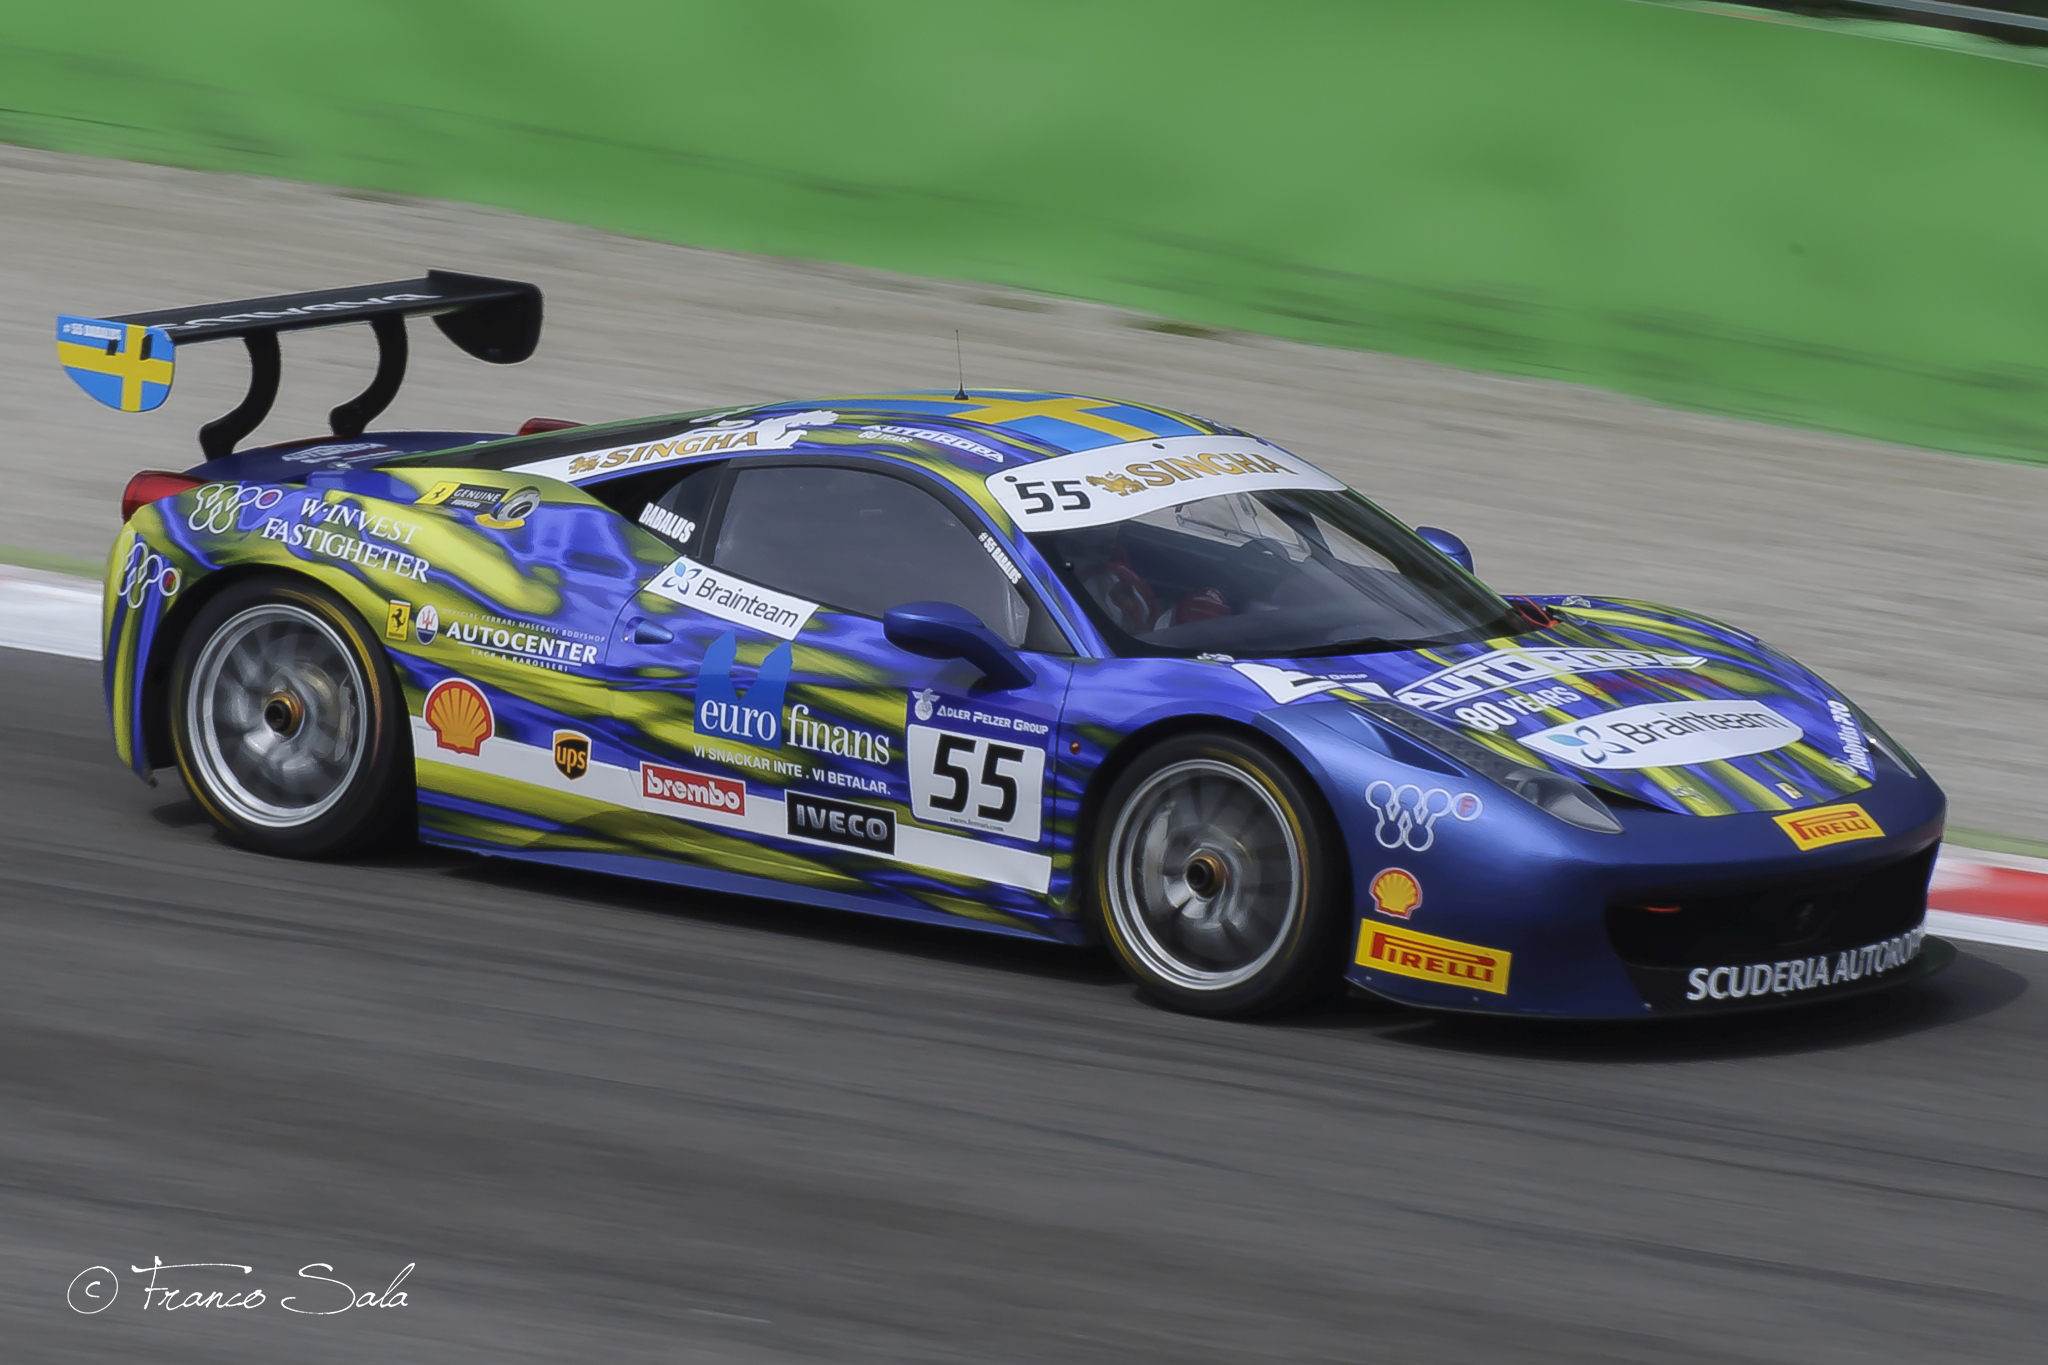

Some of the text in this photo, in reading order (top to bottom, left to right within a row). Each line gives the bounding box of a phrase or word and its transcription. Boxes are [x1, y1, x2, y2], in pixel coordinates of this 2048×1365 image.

[599, 431, 758, 468] SINGHA
[1125, 452, 1299, 487] SINGHA
[453, 488, 502, 503] GENUINE
[1014, 480, 1091, 515] 55
[638, 502, 696, 544] BABALUS
[261, 517, 430, 583] FASTIGHETER
[695, 576, 799, 629] Brainteam
[441, 608, 607, 643] OFFICIAL FERRARI MASERATI BODYSHOP
[446, 621, 598, 665] AUTOCENTER
[471, 648, 497, 659] LACK
[512, 656, 569, 673] KAROSSERI
[936, 704, 1049, 735] ADLER PELZER GROUP
[1454, 685, 1583, 733] 80 YEARS
[1606, 711, 1790, 745] Brainteam
[700, 699, 890, 766] euro finans
[556, 745, 587, 774] ups
[693, 743, 705, 759] VI
[708, 747, 771, 771] SNACKAR
[773, 760, 803, 778] INTE
[811, 767, 825, 782] VI
[827, 771, 892, 796] BETALAR.
[929, 732, 1025, 823] 55
[647, 769, 741, 811] brembo
[795, 803, 888, 841] IVECO
[1788, 810, 1873, 841] PIRELLI
[1369, 931, 1497, 983] PIRELLI
[1686, 956, 1830, 1001] SCUDERIA
